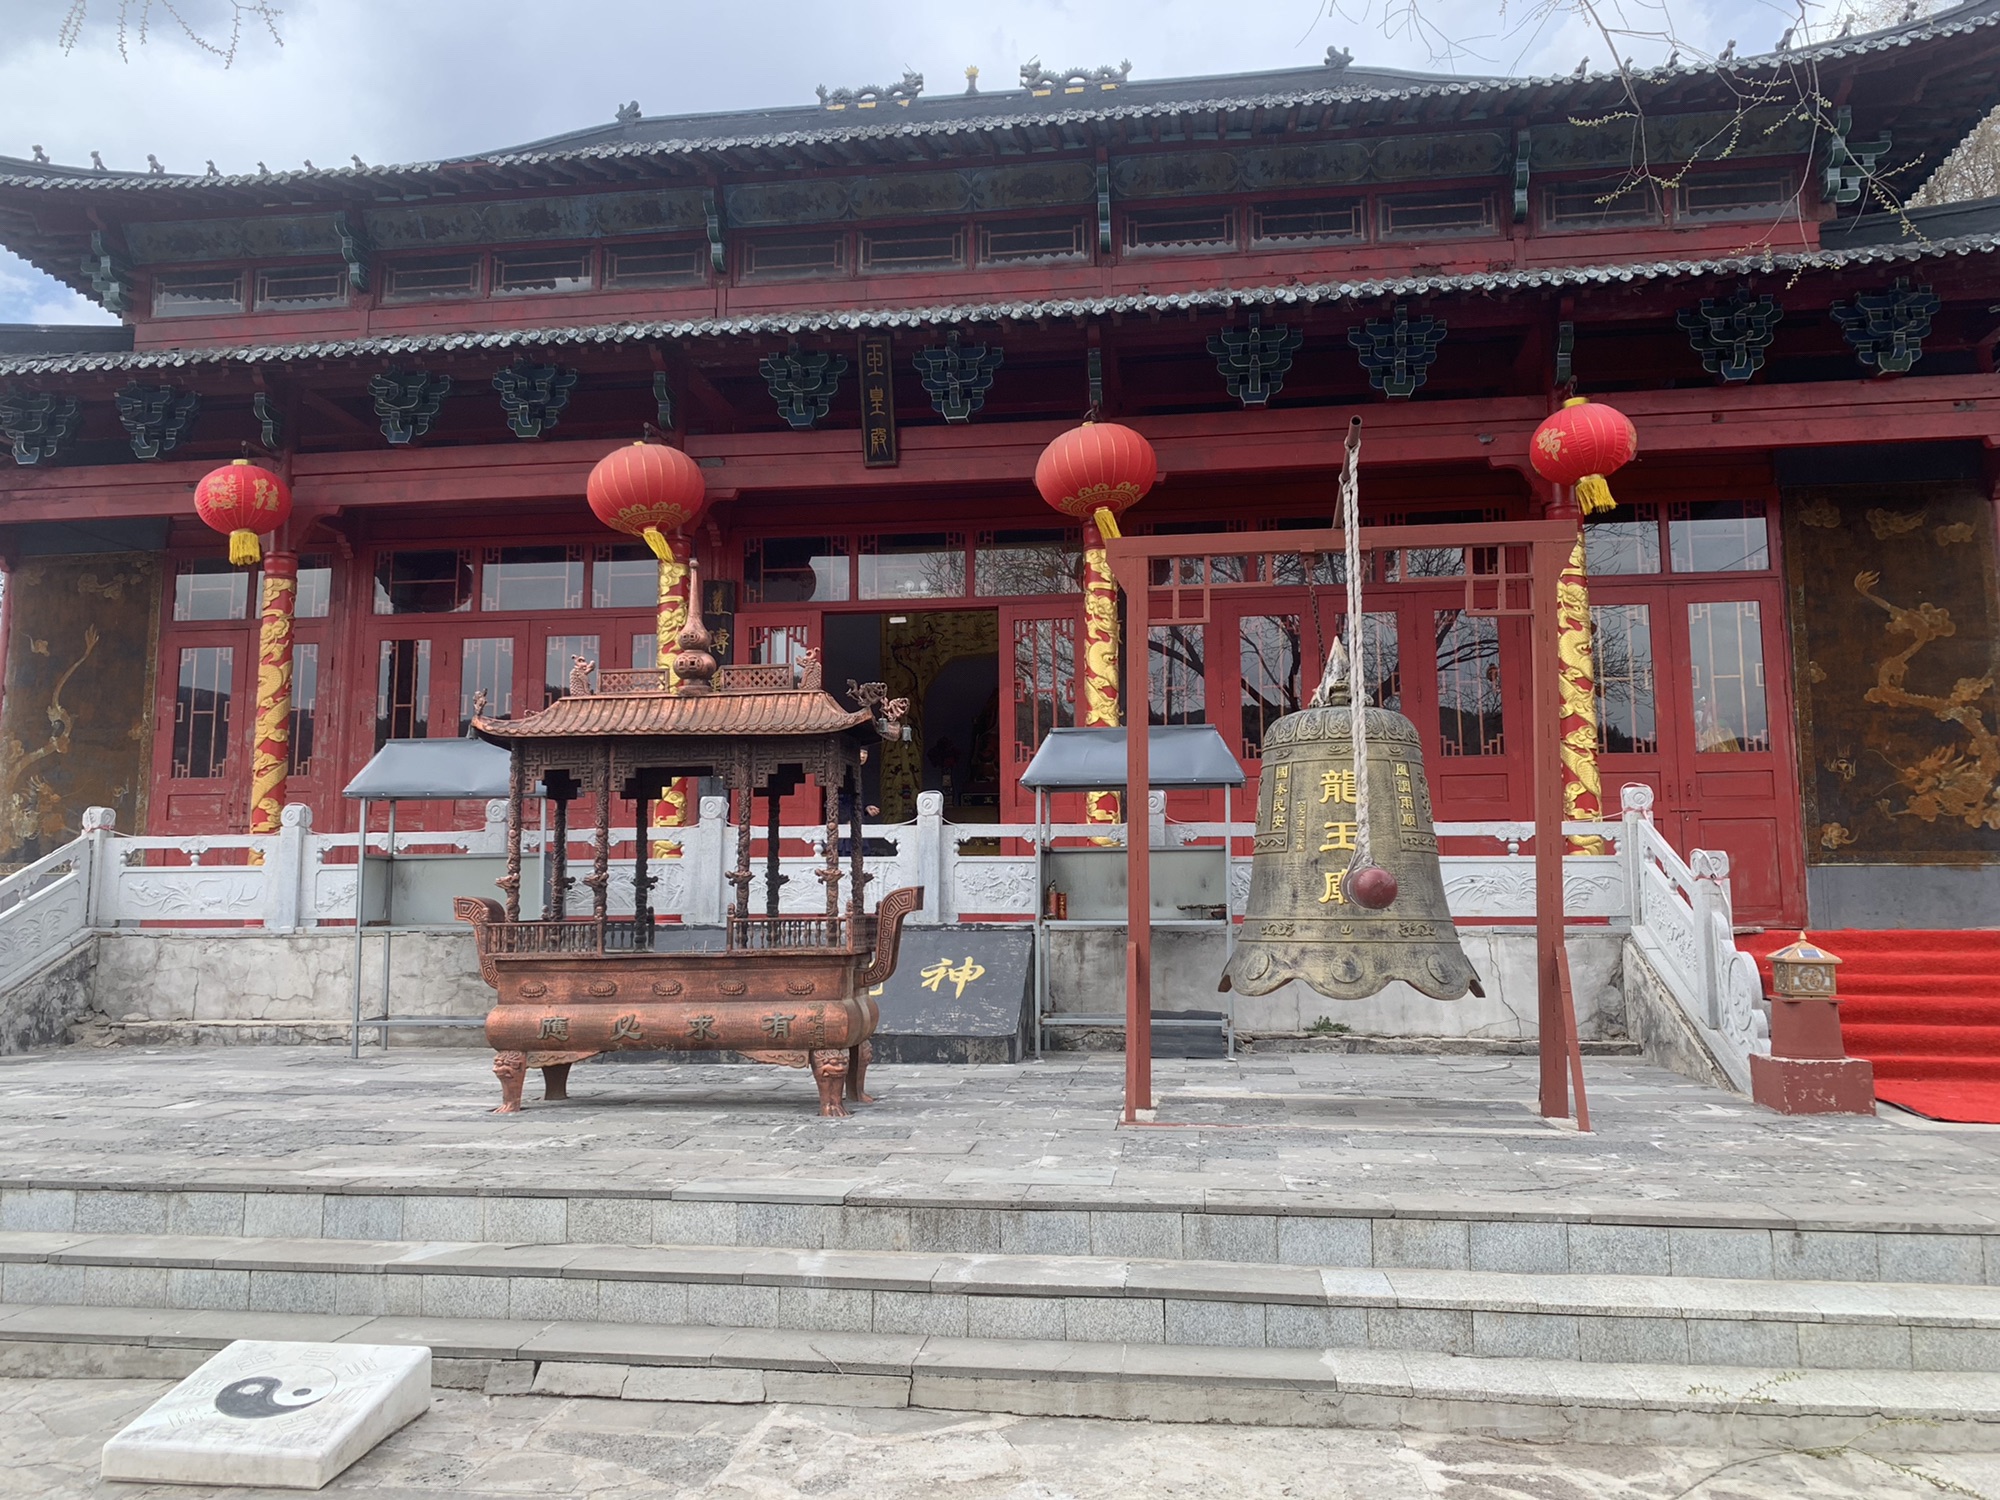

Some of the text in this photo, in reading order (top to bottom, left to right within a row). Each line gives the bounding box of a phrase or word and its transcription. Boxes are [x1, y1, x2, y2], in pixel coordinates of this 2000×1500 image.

[1272, 765, 1289, 829] 國泰民安
[1394, 763, 1416, 827] 風調雨順
[536, 1012, 798, 1041] 有求必應
